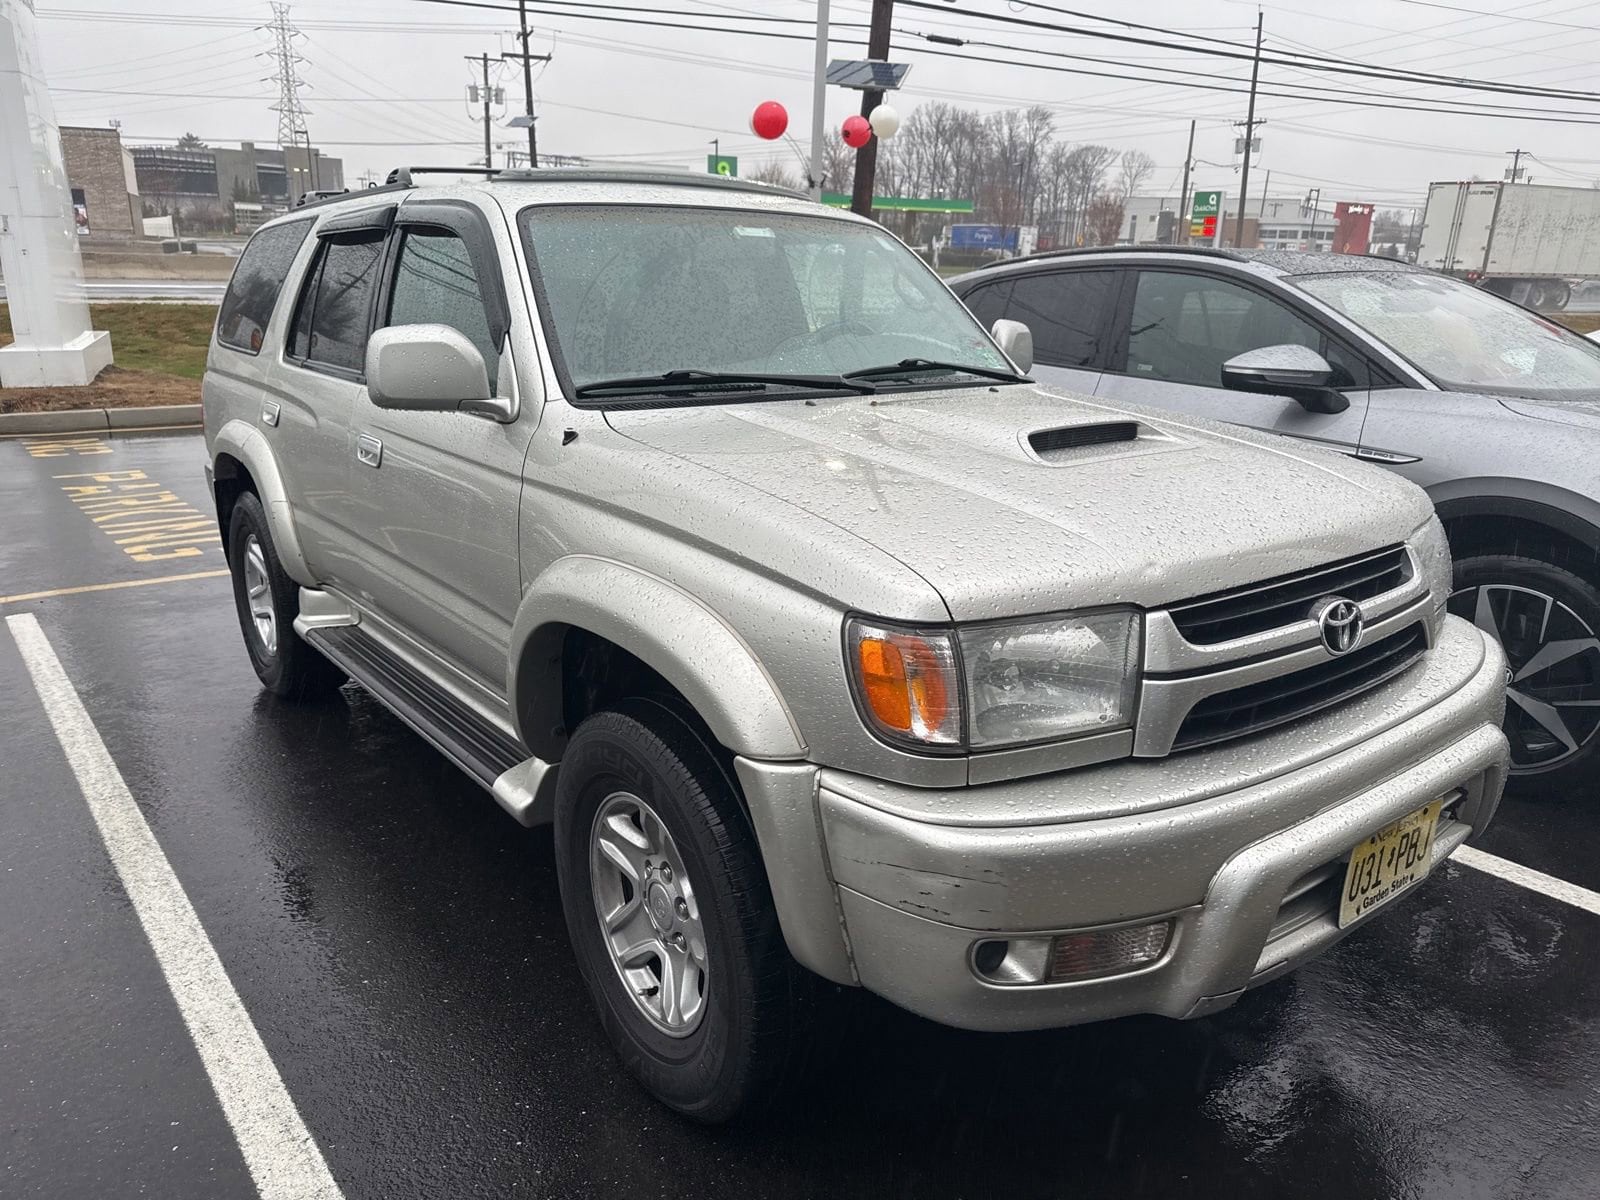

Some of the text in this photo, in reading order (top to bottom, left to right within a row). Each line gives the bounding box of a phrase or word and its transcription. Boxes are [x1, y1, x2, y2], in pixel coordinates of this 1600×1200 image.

[21, 438, 113, 457] NO
[52, 469, 220, 562] PARKING
[1348, 845, 1385, 902] U31
[1363, 874, 1409, 909] Garden State
